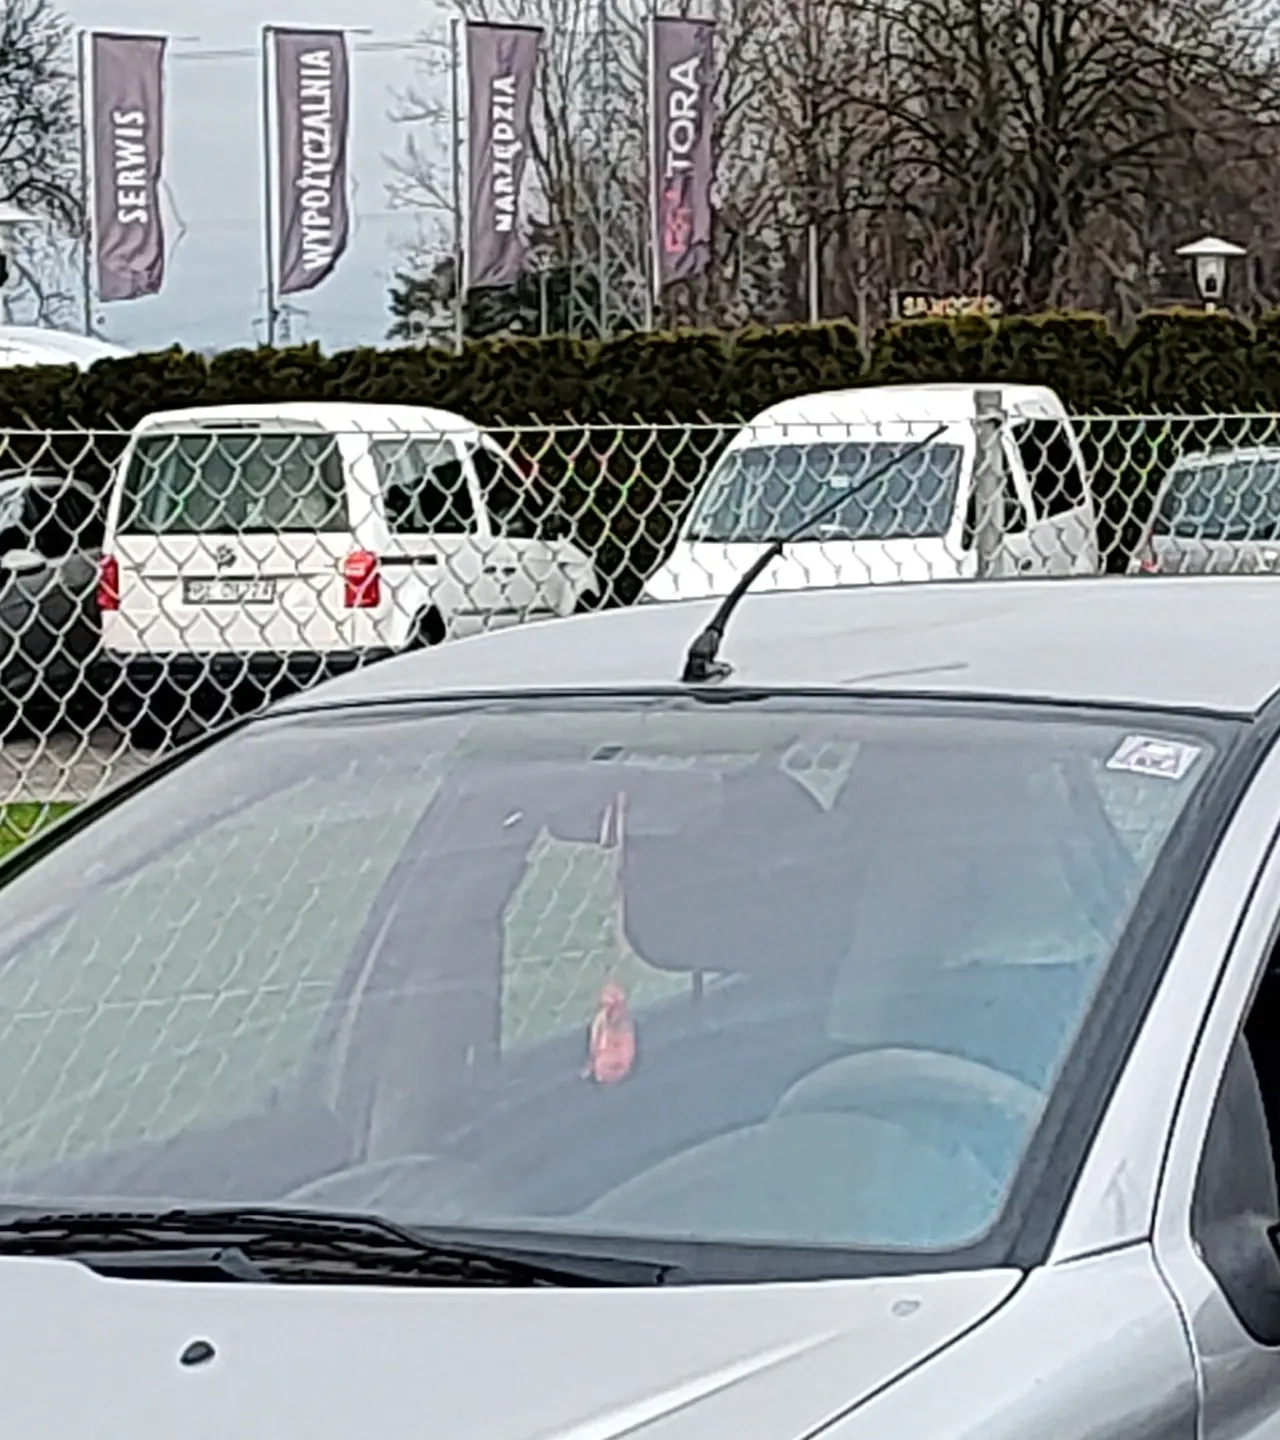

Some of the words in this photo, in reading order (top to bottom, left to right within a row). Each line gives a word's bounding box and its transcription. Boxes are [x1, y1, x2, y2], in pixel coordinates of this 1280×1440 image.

[113, 110, 149, 224] SERWIS
[294, 50, 333, 271] WYPOŻYCZALNIA
[492, 75, 523, 232] NARZĘDZIA
